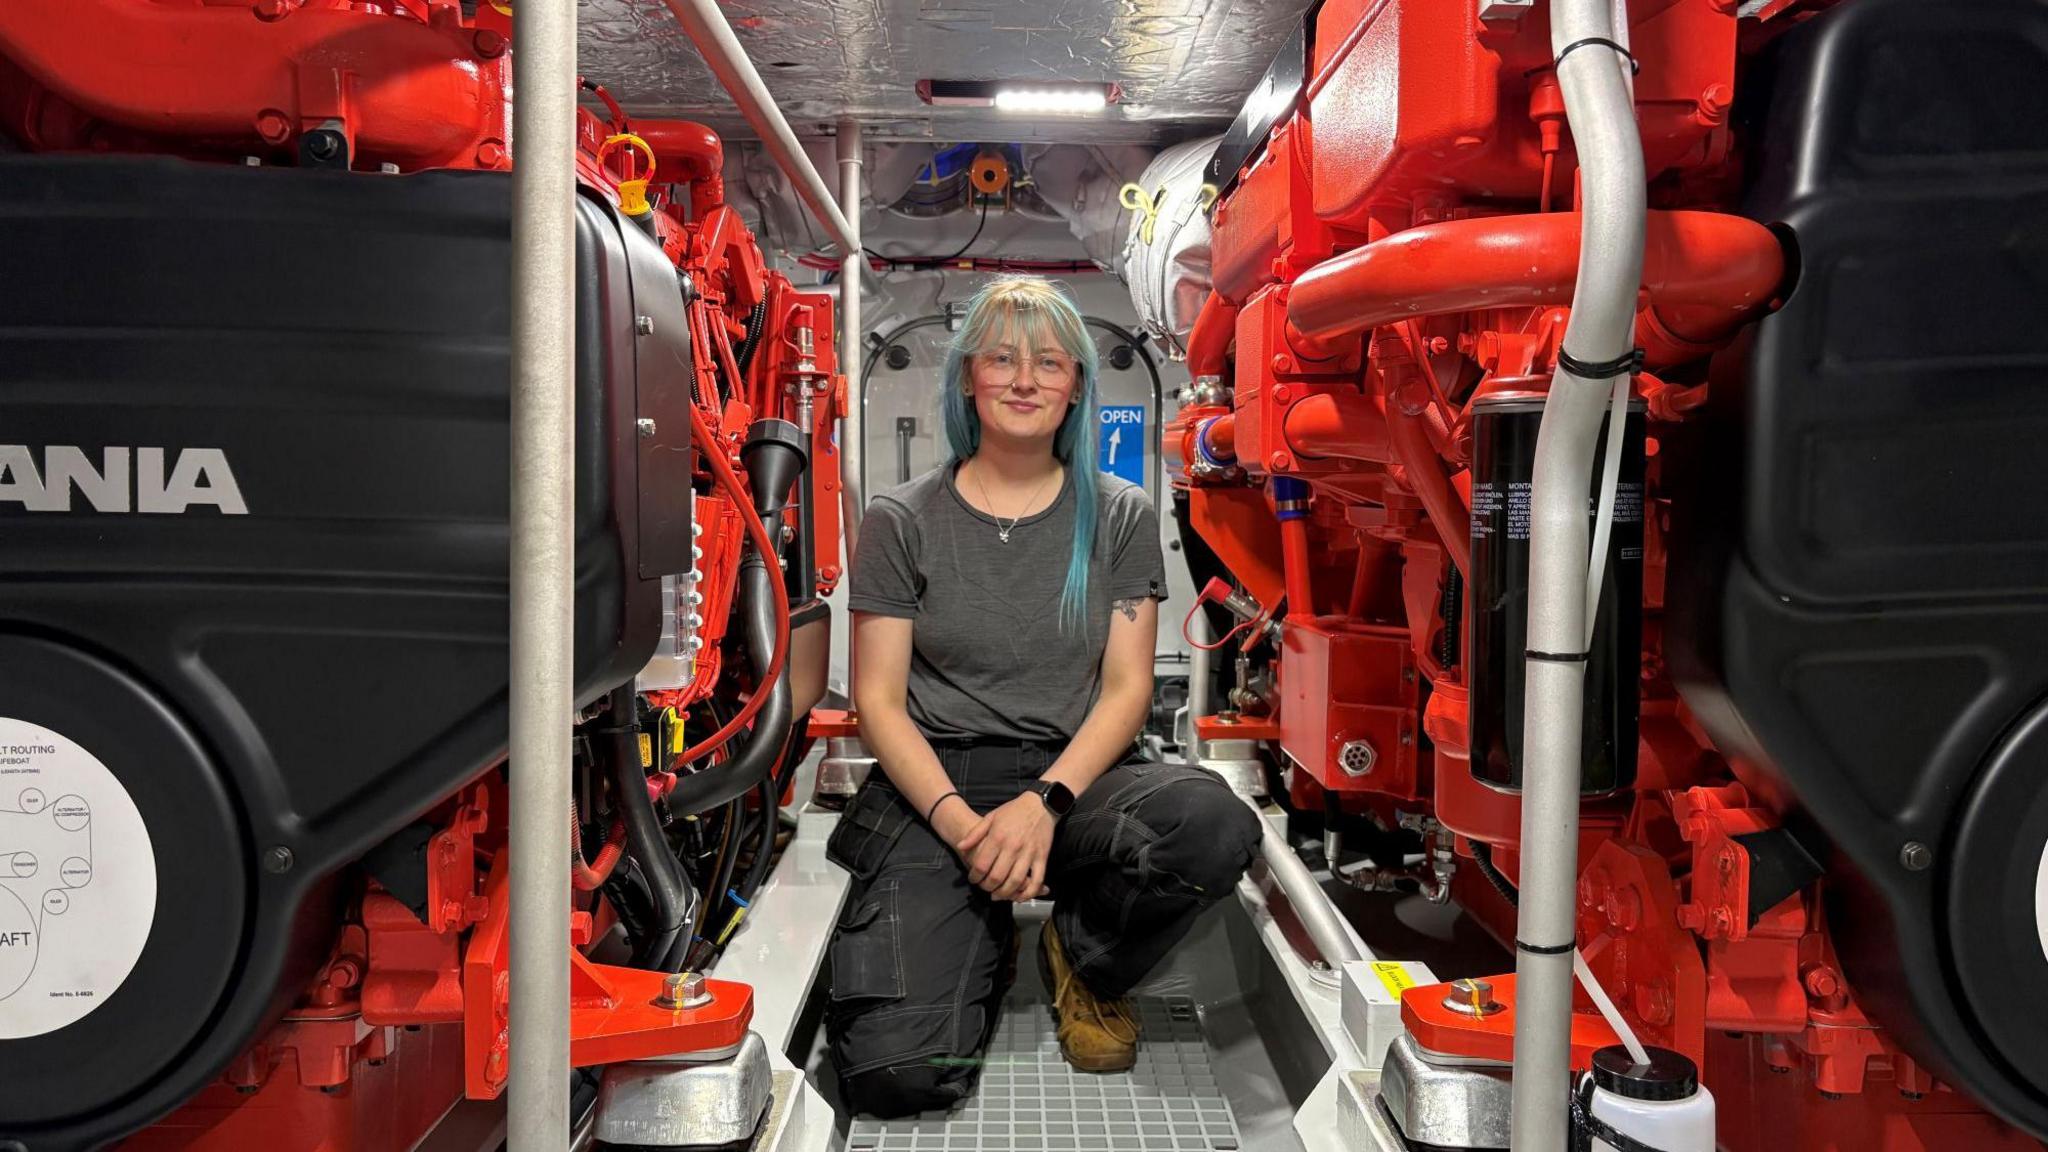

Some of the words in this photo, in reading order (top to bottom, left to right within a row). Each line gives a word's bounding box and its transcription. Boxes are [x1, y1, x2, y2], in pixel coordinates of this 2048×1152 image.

[1100, 410, 1142, 424] OPEN
[0, 746, 8, 755] T
[11, 745, 55, 754] ROUTING
[0, 932, 31, 946] AFT
